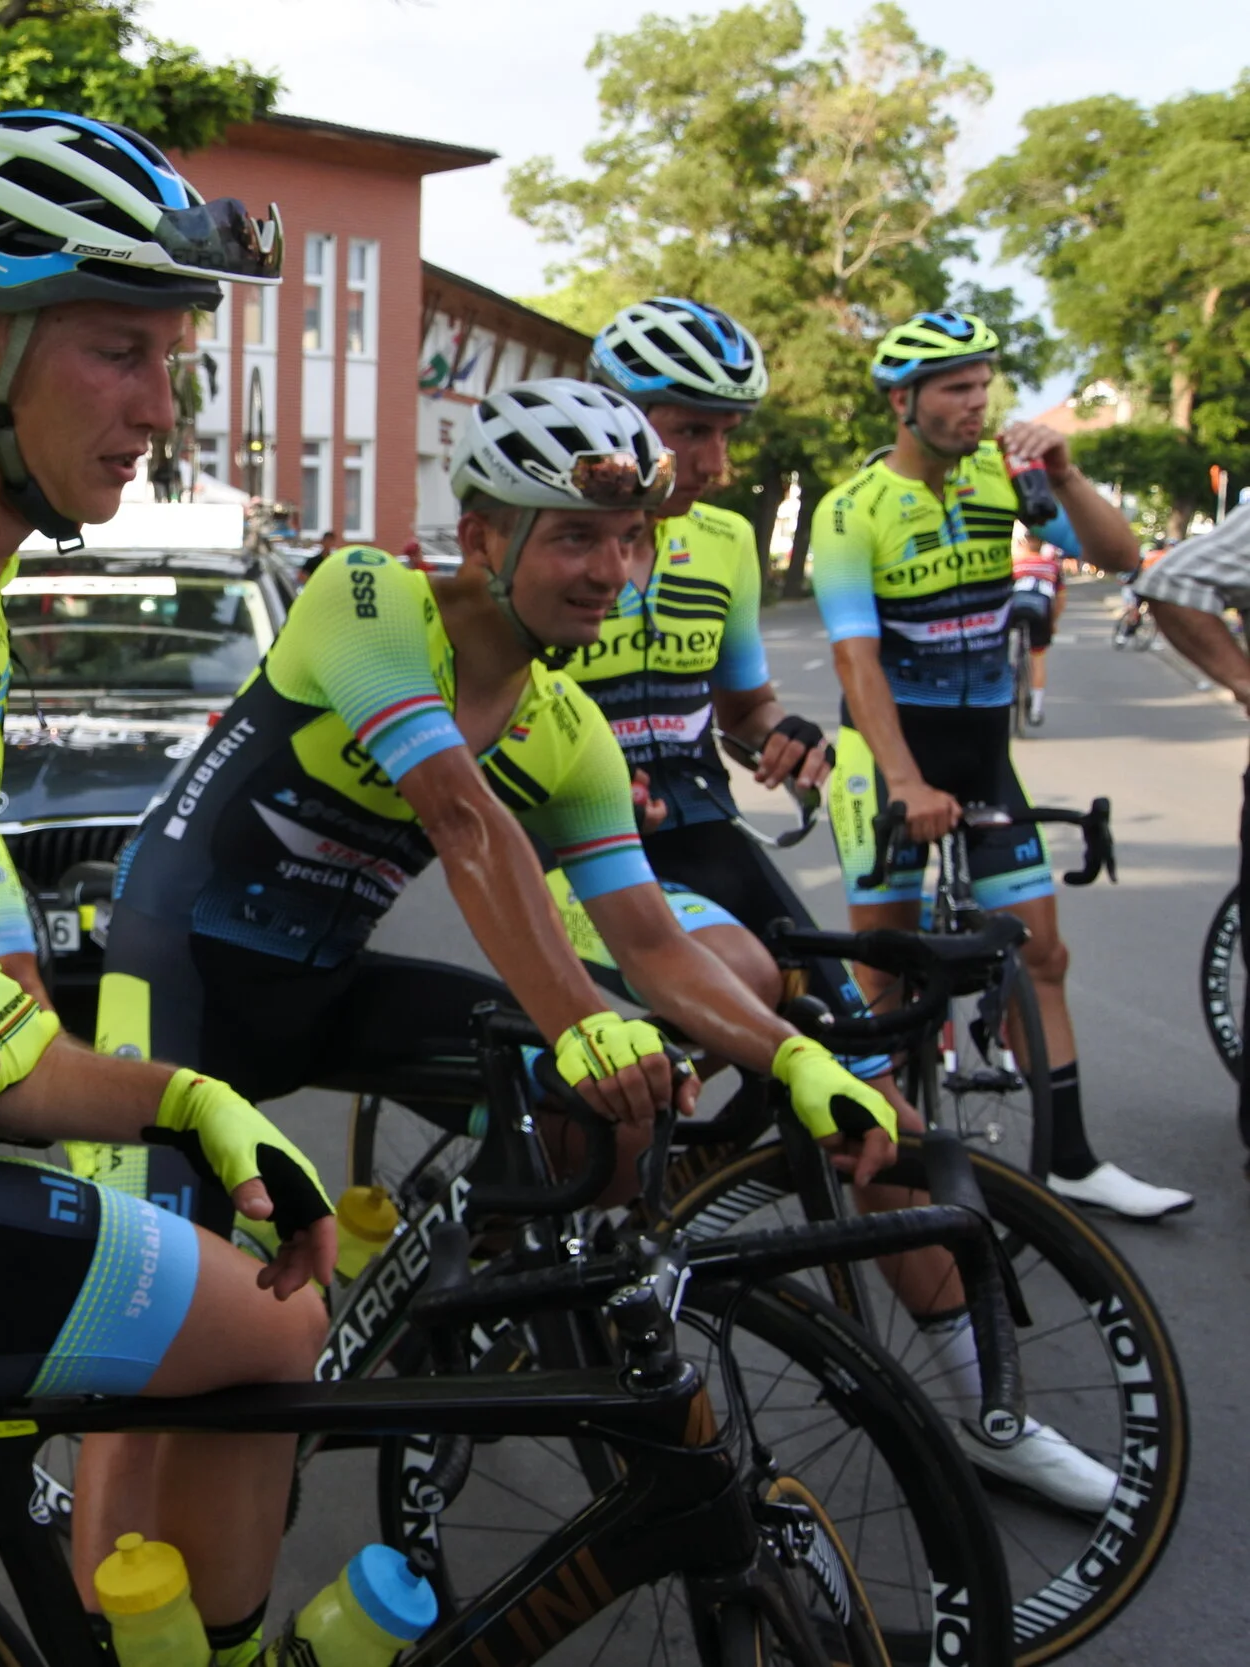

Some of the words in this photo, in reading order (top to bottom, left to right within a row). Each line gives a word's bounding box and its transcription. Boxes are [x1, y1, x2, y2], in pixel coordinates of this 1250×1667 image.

[351, 569, 379, 620] BSS
[176, 717, 257, 817] GEBERIT
[277, 857, 349, 890] special
